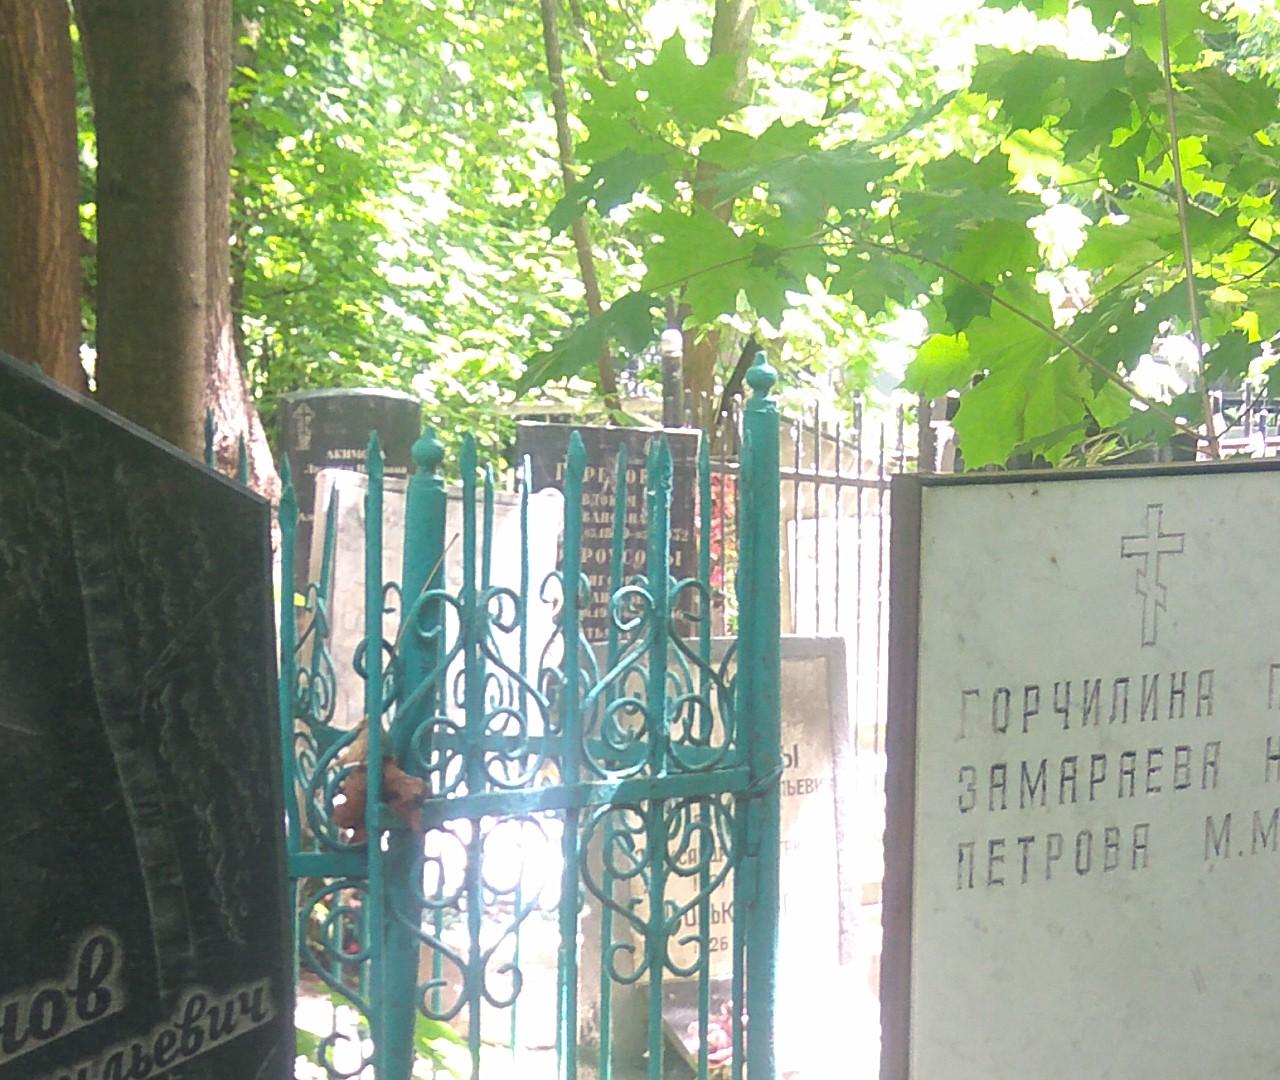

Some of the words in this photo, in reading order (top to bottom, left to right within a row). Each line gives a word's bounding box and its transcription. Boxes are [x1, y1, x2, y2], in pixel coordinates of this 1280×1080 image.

[956, 669, 1215, 741] ГОРЧИЛИНА
[957, 741, 1221, 813] ЗАМАРАЕВА
[956, 823, 1150, 890] ПЕТРОВА
